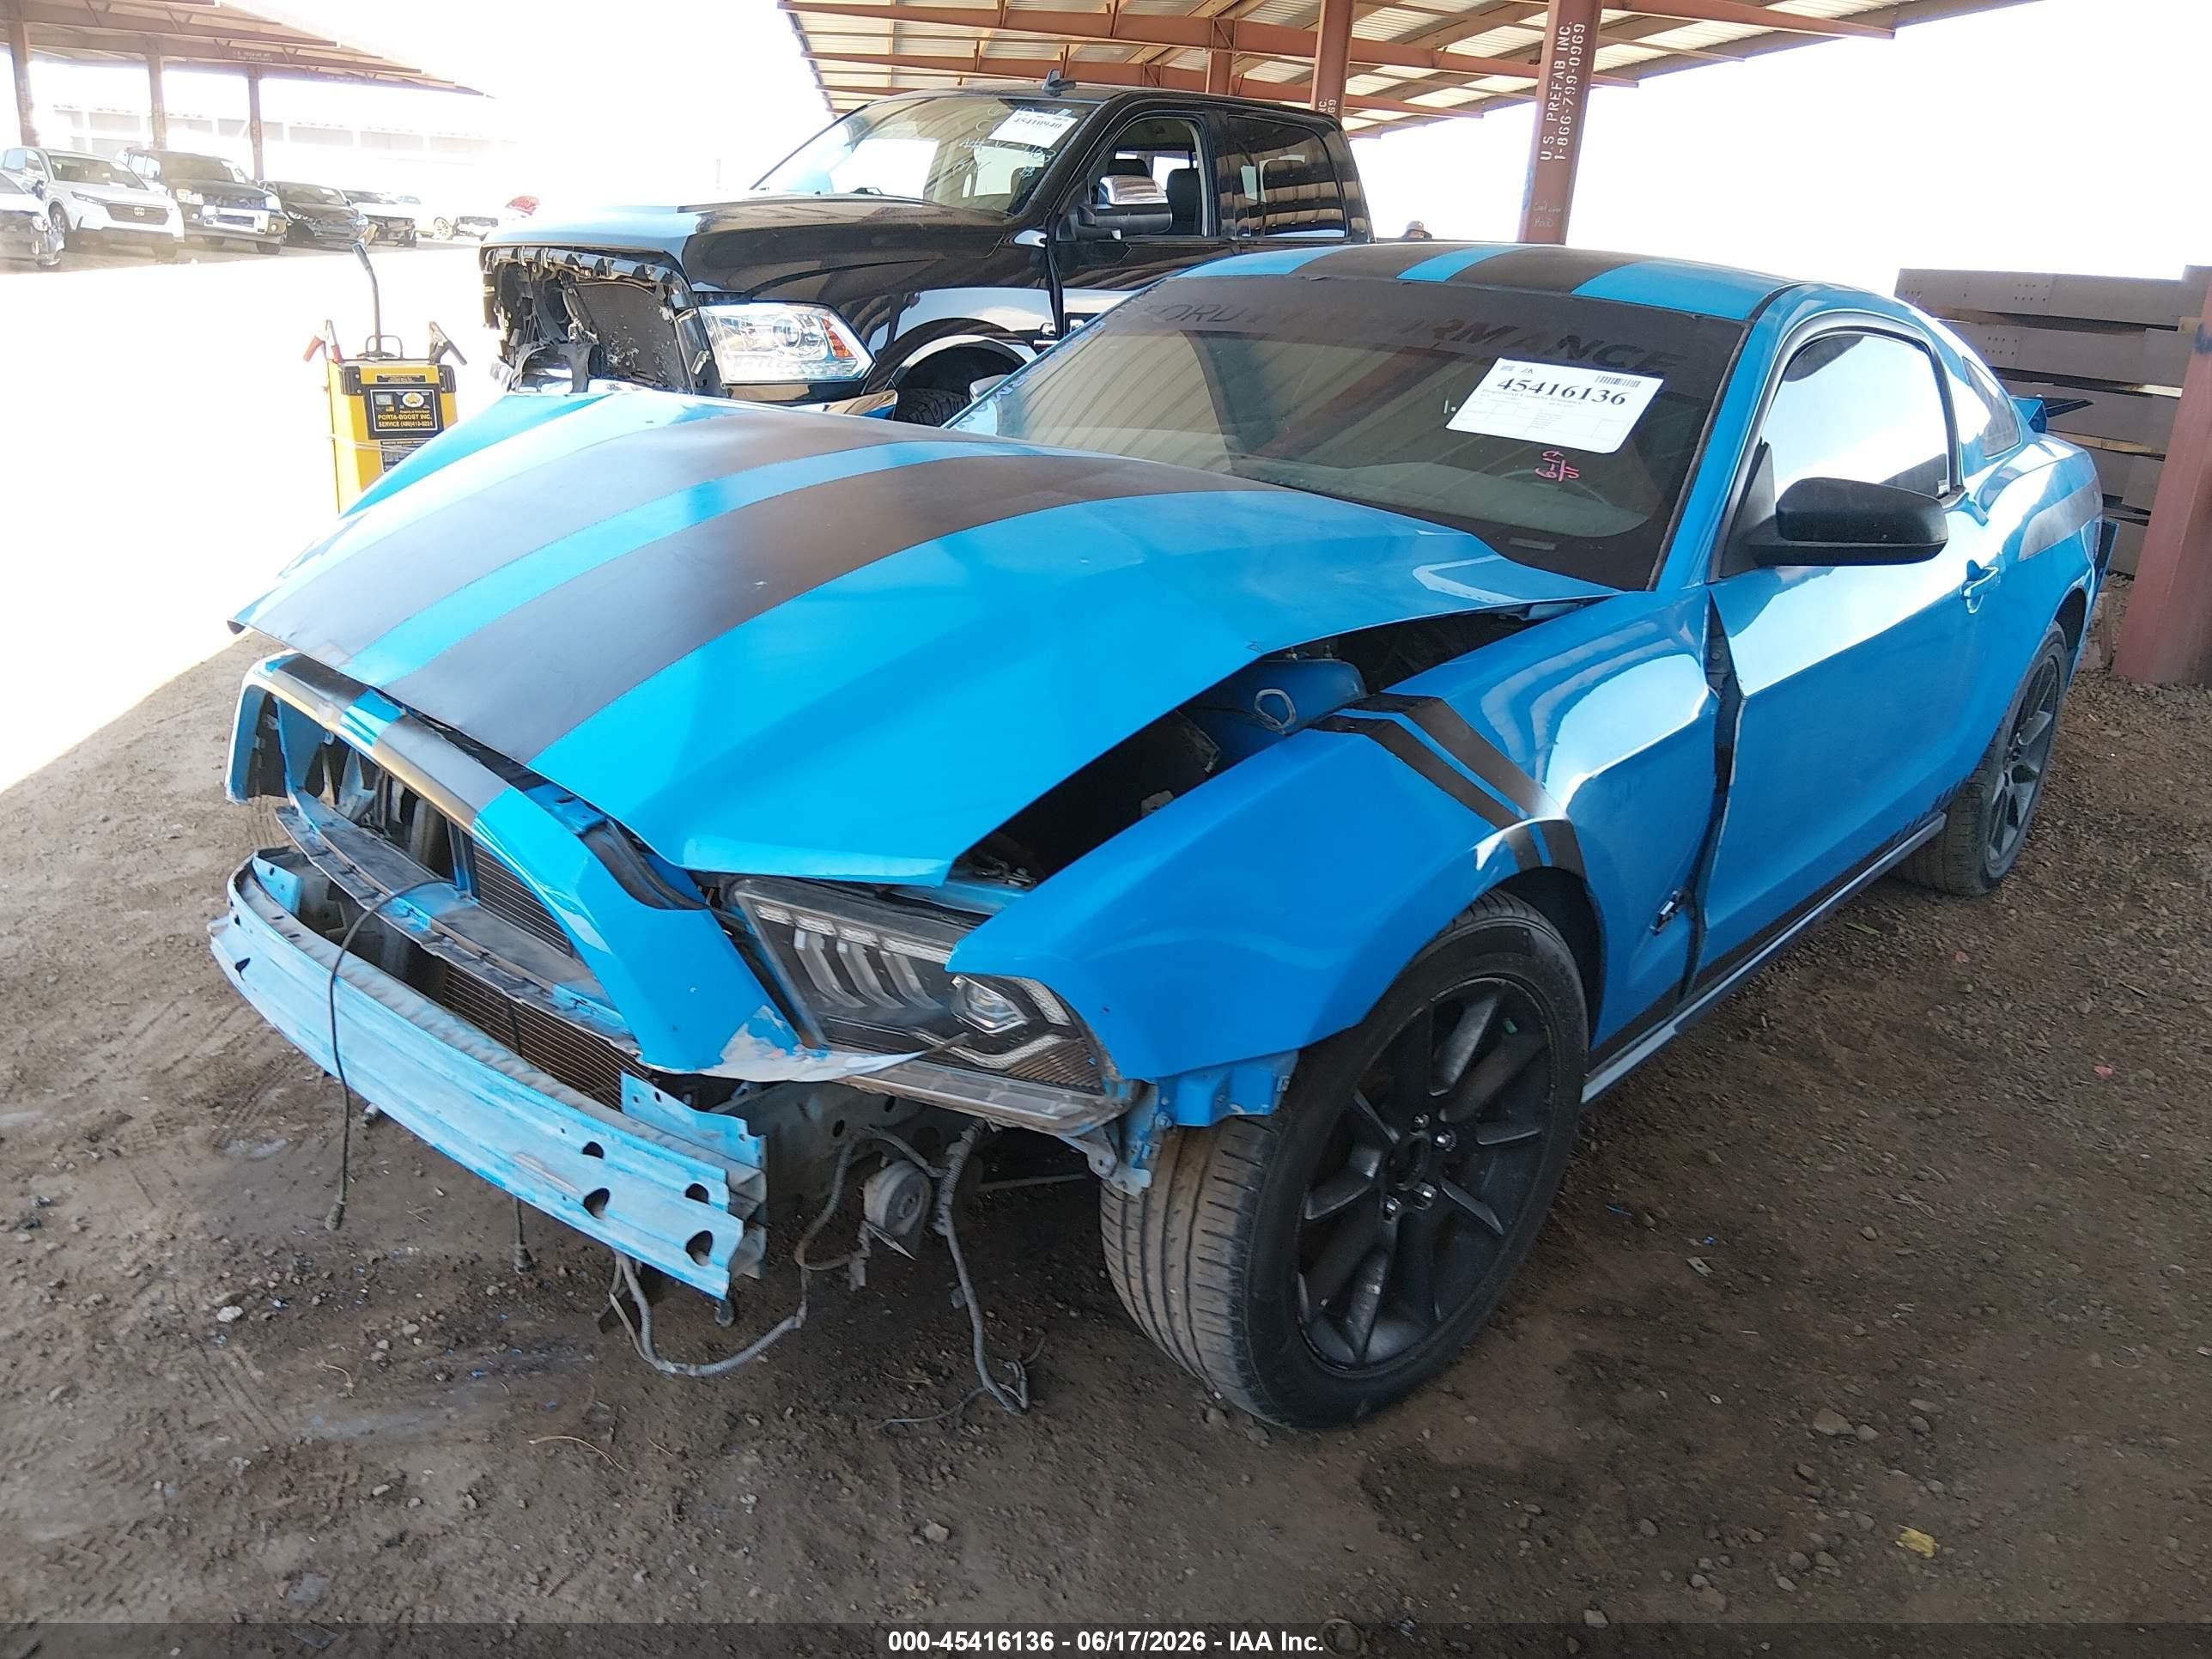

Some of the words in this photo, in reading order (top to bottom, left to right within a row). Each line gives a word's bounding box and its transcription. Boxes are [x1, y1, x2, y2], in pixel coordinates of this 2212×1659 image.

[1556, 21, 1573, 52] INC.
[1546, 60, 1565, 121] PREFAB
[1553, 23, 1586, 161] 1-866-799-0969
[1540, 130, 1556, 161] U.S.
[1497, 378, 1632, 406] 45416136
